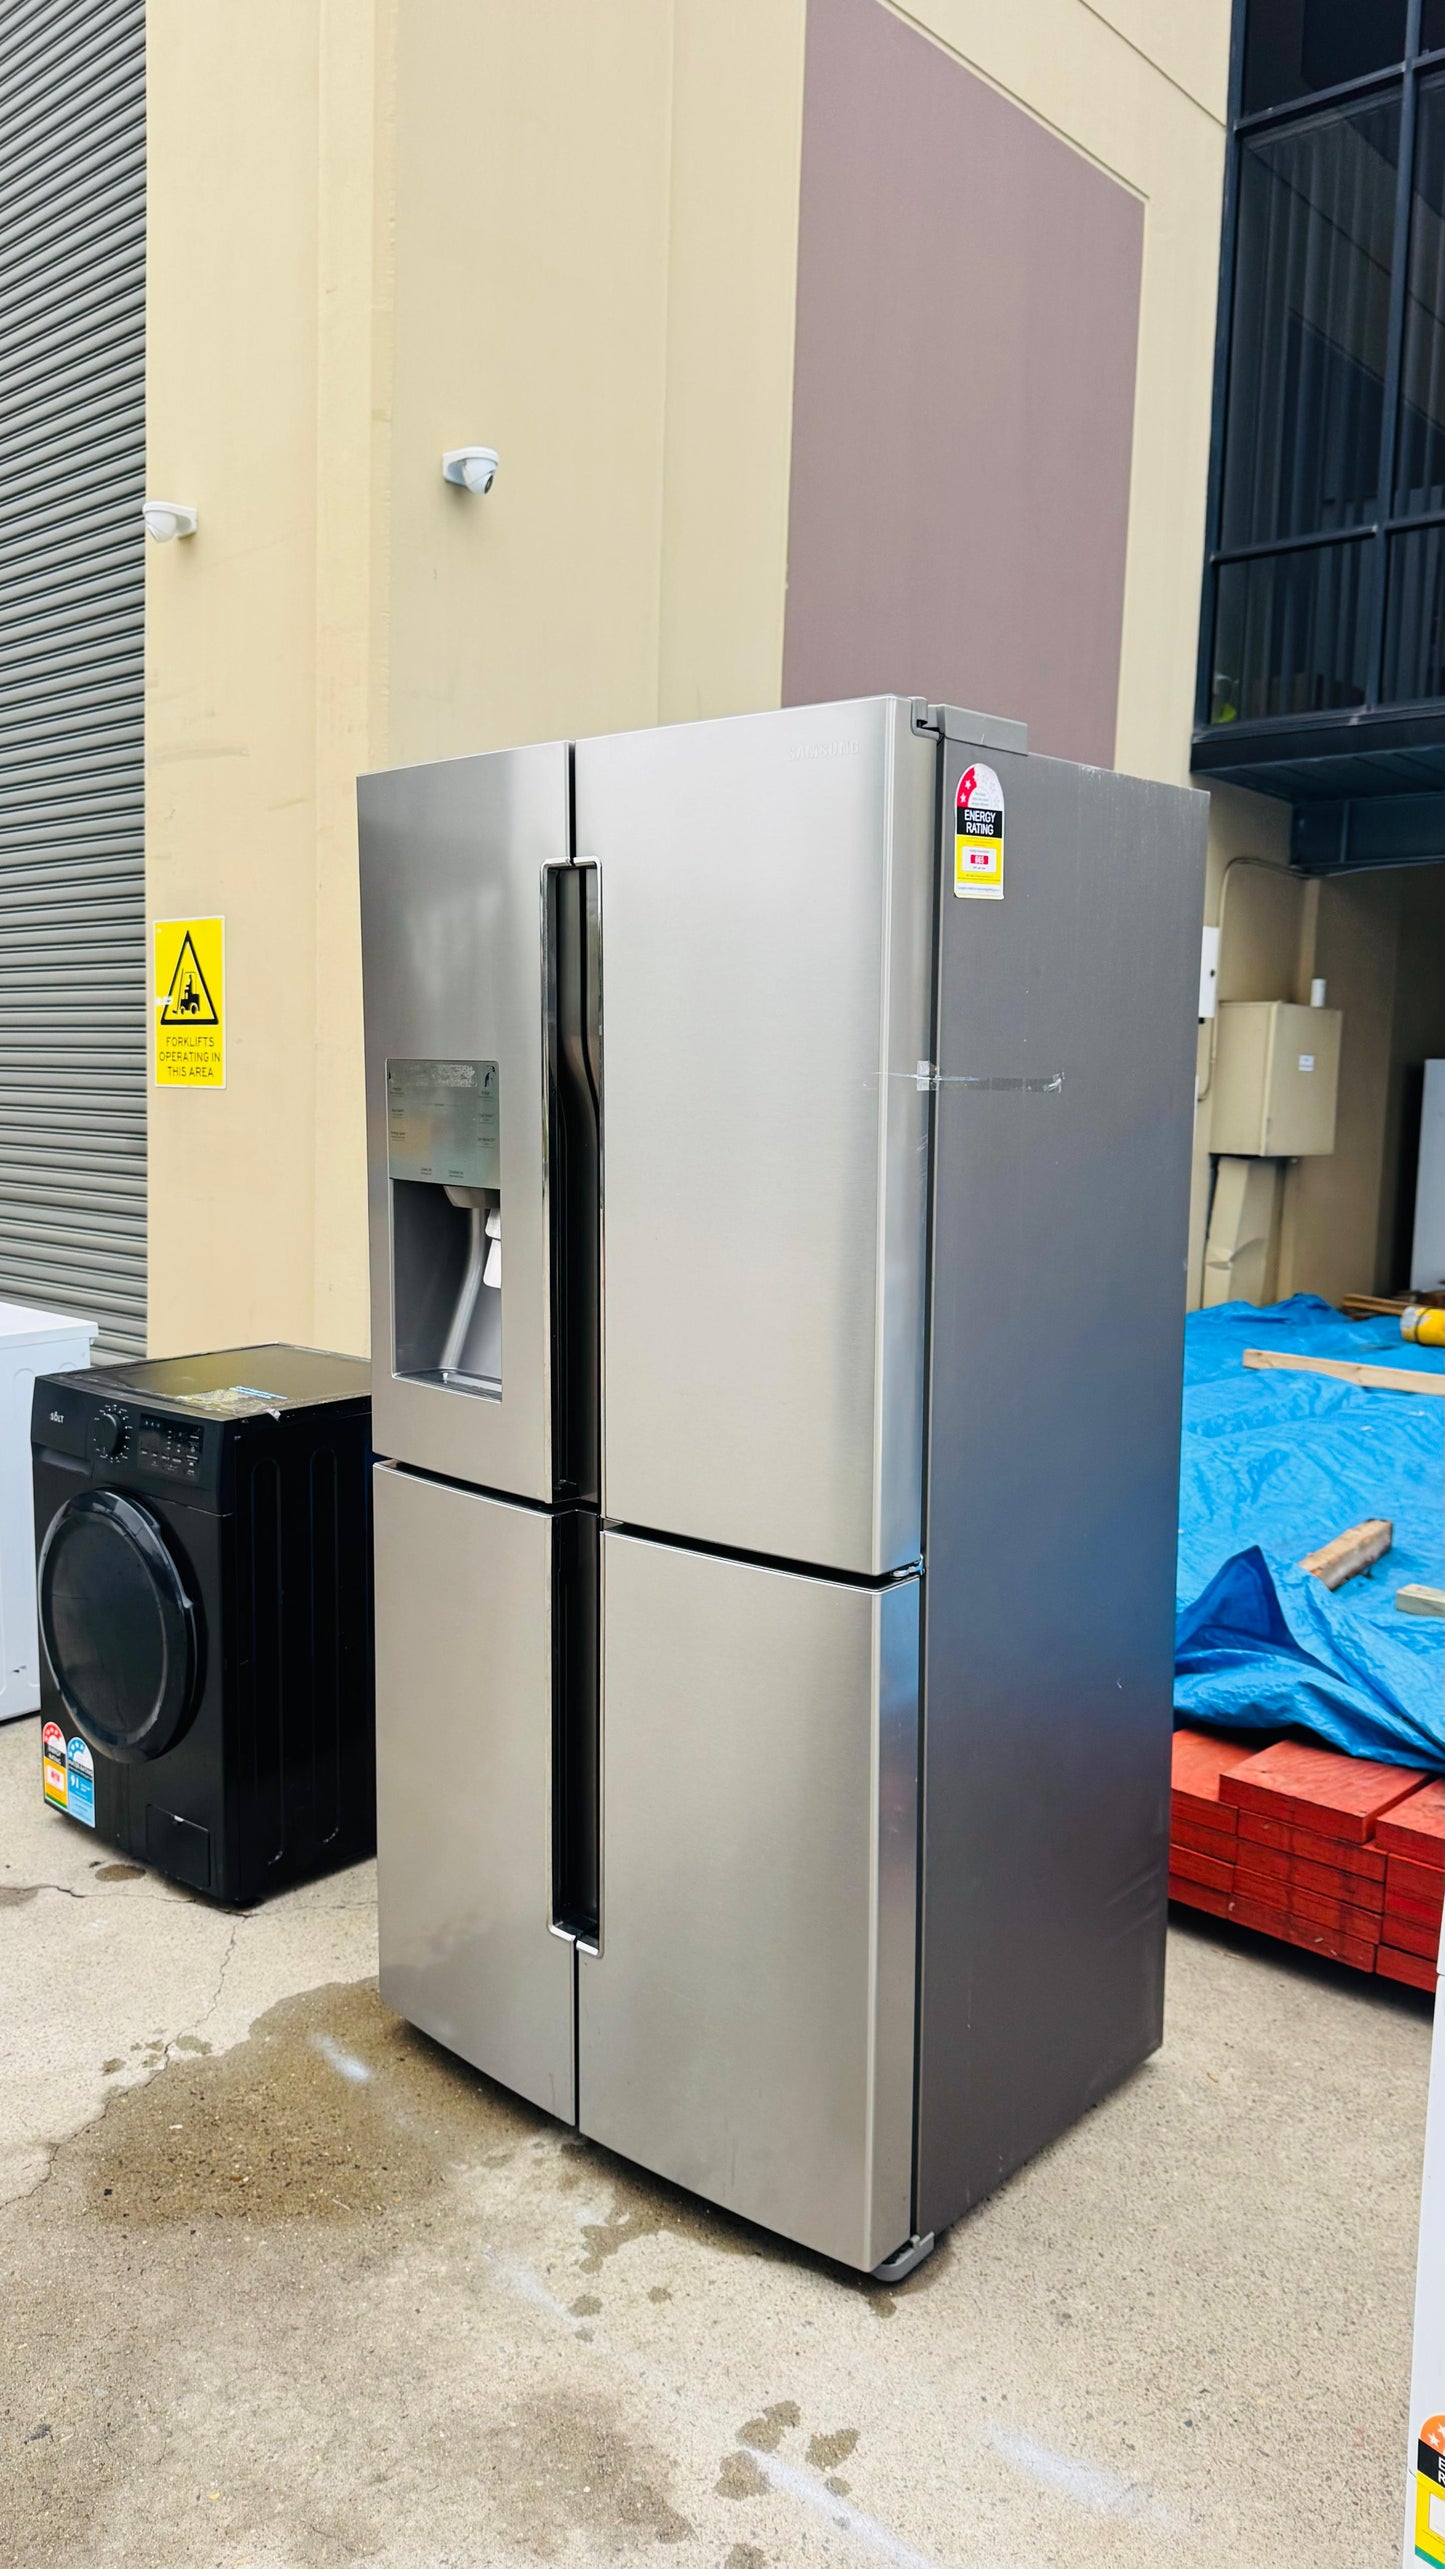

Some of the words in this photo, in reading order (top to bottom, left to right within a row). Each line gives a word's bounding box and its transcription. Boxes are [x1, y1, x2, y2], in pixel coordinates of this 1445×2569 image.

[787, 739, 860, 760] SAMSUNG
[964, 809, 996, 823] ENERGY
[966, 822, 994, 836] RATING
[166, 1036, 215, 1047] FORKLIFTS
[159, 1051, 209, 1062] OPERATING
[211, 1052, 221, 1062] IN
[167, 1066, 186, 1077] THIS
[189, 1067, 214, 1077] AREA
